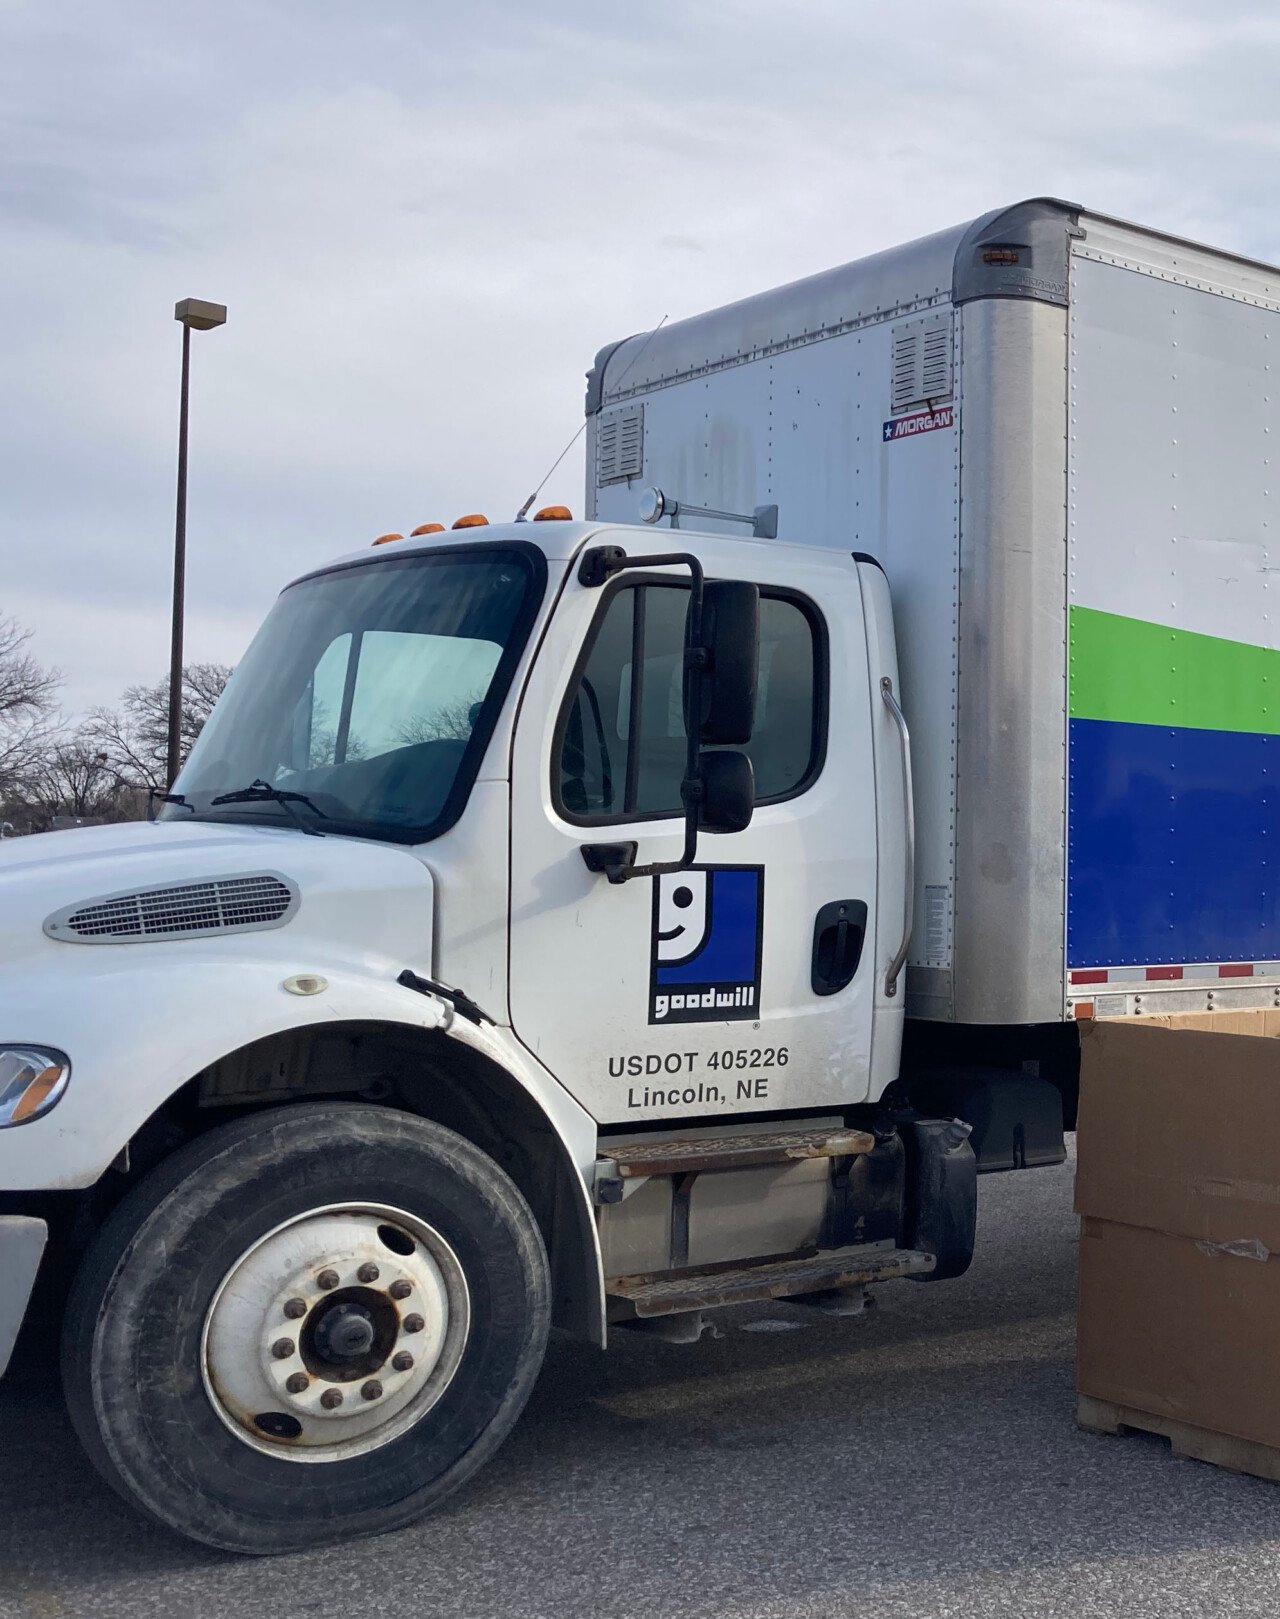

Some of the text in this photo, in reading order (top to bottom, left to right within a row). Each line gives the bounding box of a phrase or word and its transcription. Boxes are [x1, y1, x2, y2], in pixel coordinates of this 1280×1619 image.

[894, 410, 951, 437] MORGAN
[655, 986, 755, 1019] goodwill
[608, 1047, 790, 1078] USDOT 405226
[627, 1078, 769, 1109] Lincoln, NE
